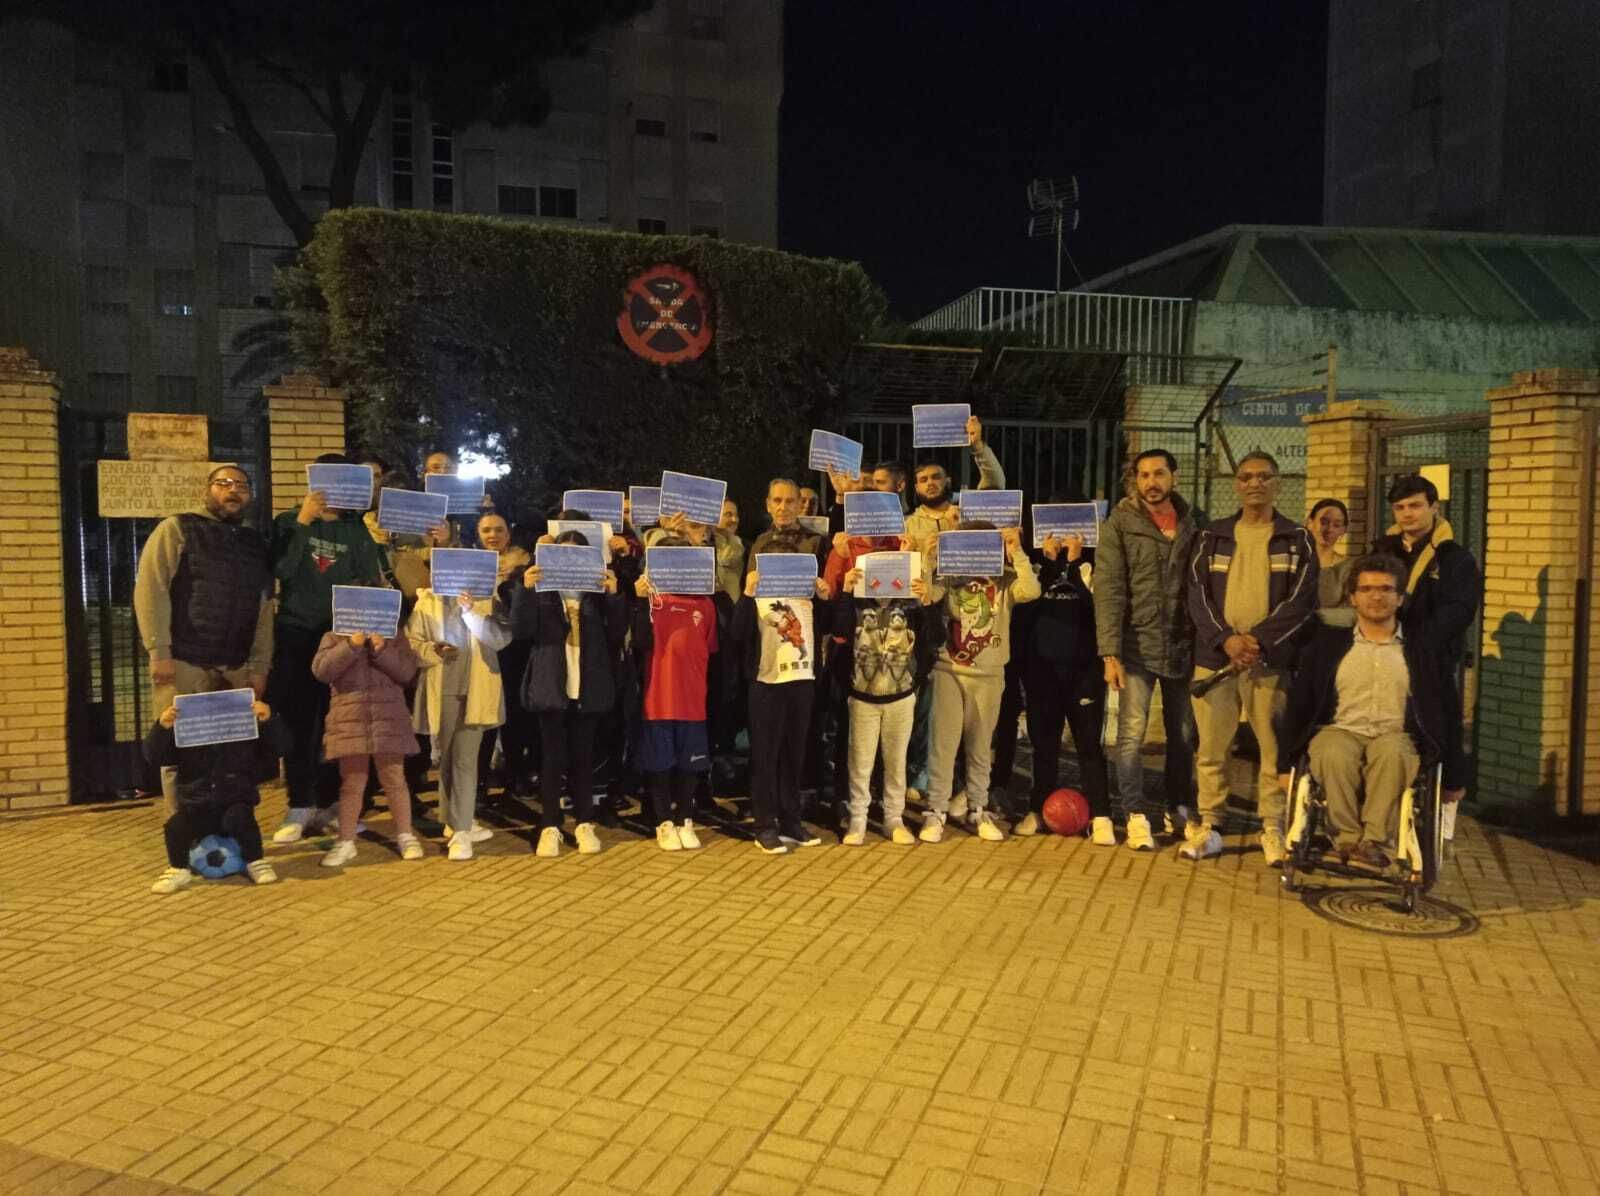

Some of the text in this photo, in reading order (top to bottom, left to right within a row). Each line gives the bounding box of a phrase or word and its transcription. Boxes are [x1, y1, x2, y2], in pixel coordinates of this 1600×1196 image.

[1242, 402, 1288, 416] CENTRO
[102, 463, 175, 474] ENTRADA A
[102, 475, 151, 486] DOCTOR
[102, 486, 127, 497] POR
[103, 498, 143, 510] JUNTO
[147, 499, 160, 510] AL
[164, 499, 186, 510] BAR
